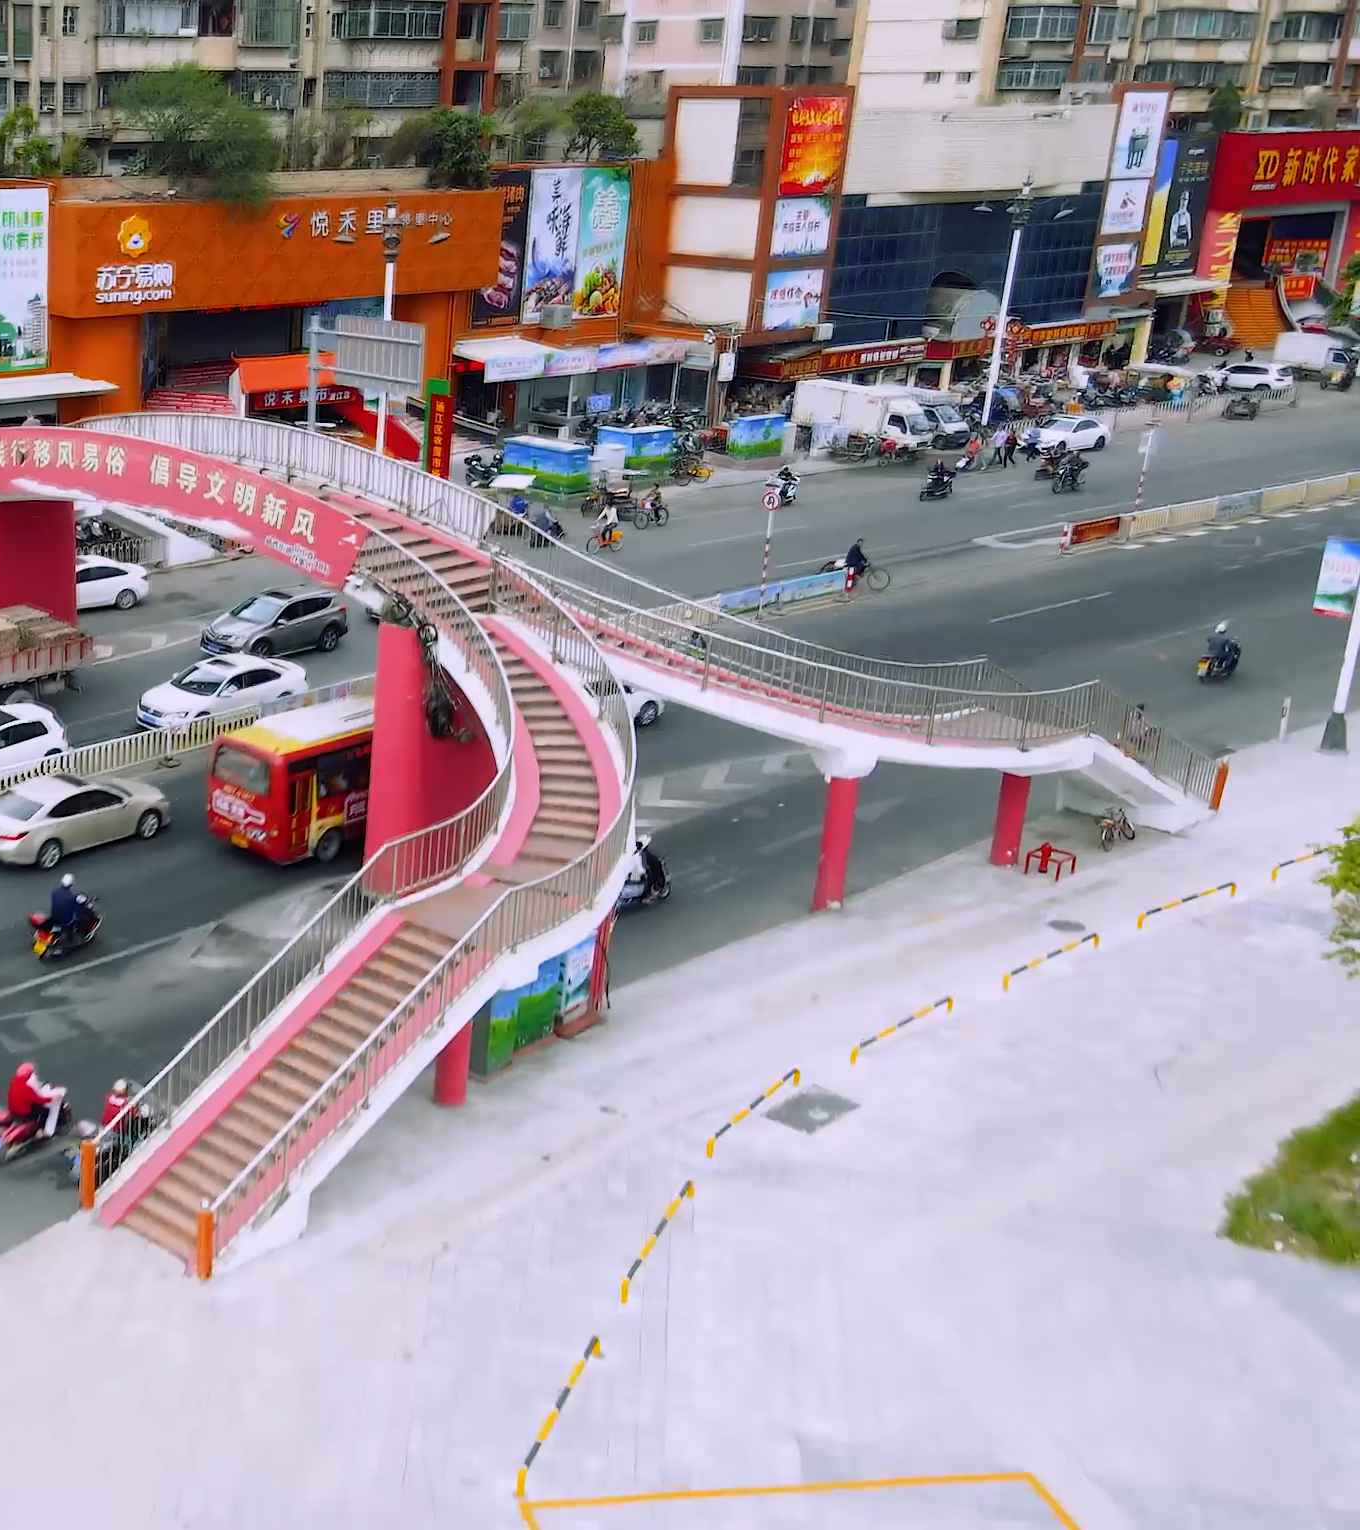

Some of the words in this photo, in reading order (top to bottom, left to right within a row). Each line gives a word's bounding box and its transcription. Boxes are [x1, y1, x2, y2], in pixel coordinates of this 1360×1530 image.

[95, 263, 173, 290] 苏宁易购
[95, 288, 172, 304] suning.com
[149, 453, 316, 545] 倡导文明新风
